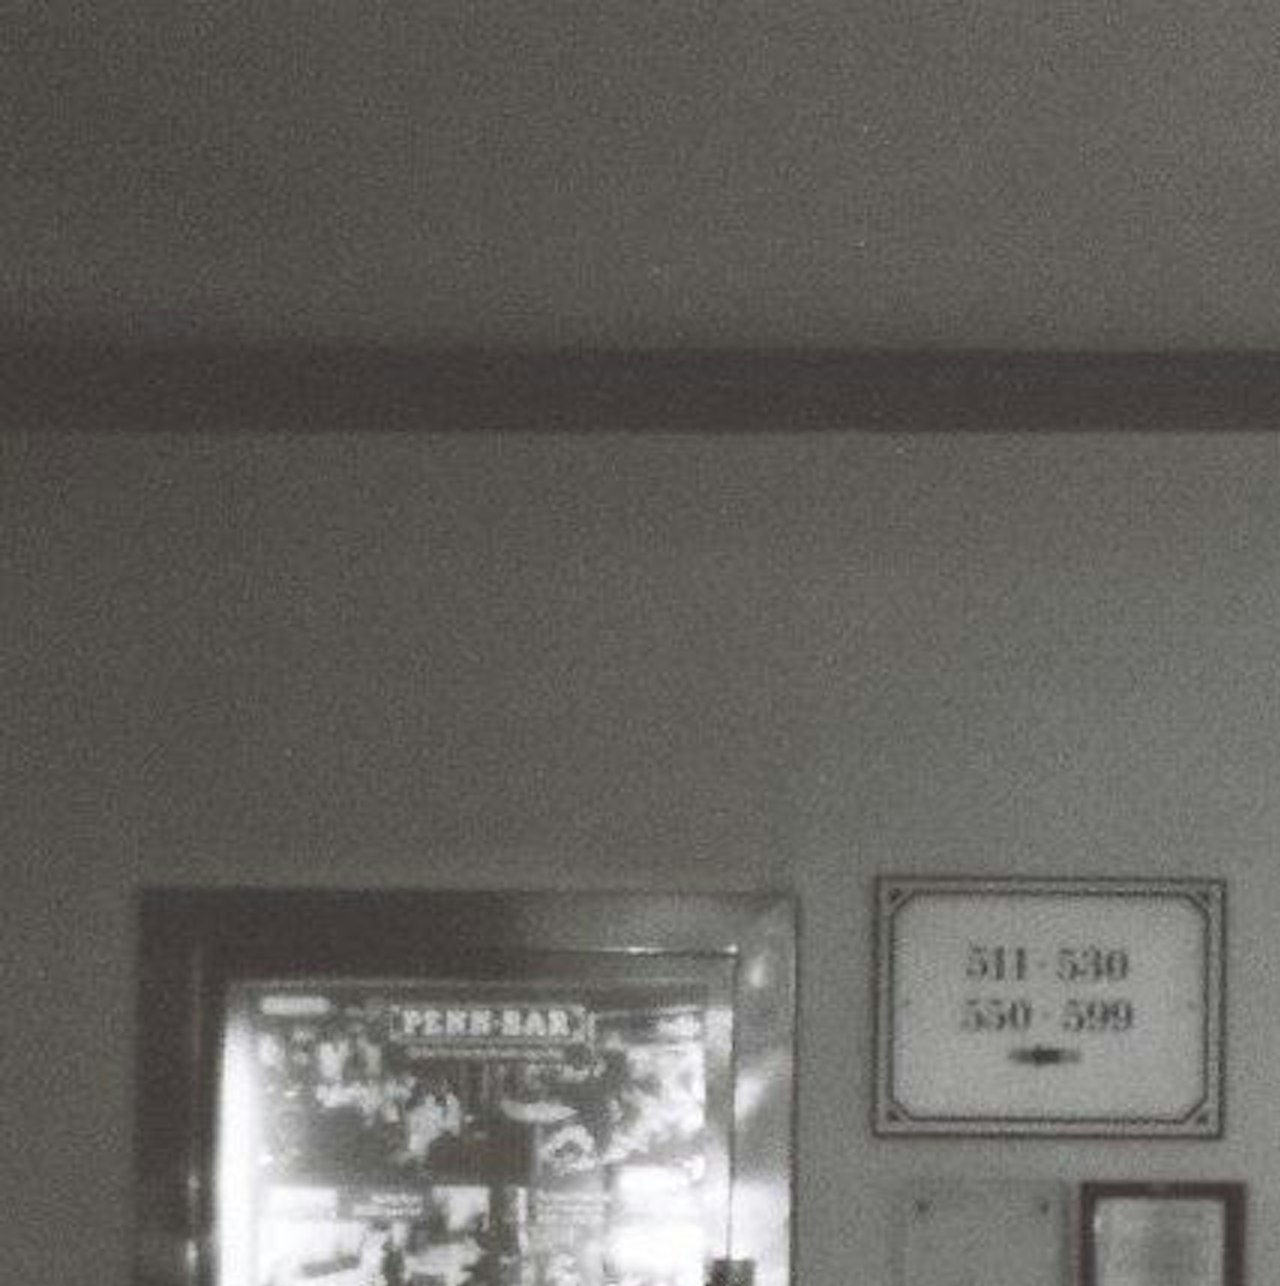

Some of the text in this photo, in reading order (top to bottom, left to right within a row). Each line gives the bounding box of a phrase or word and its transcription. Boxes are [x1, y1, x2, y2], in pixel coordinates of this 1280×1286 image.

[965, 944, 1027, 981] 511
[501, 1008, 570, 1037] BAR
[960, 998, 1032, 1031] 550
